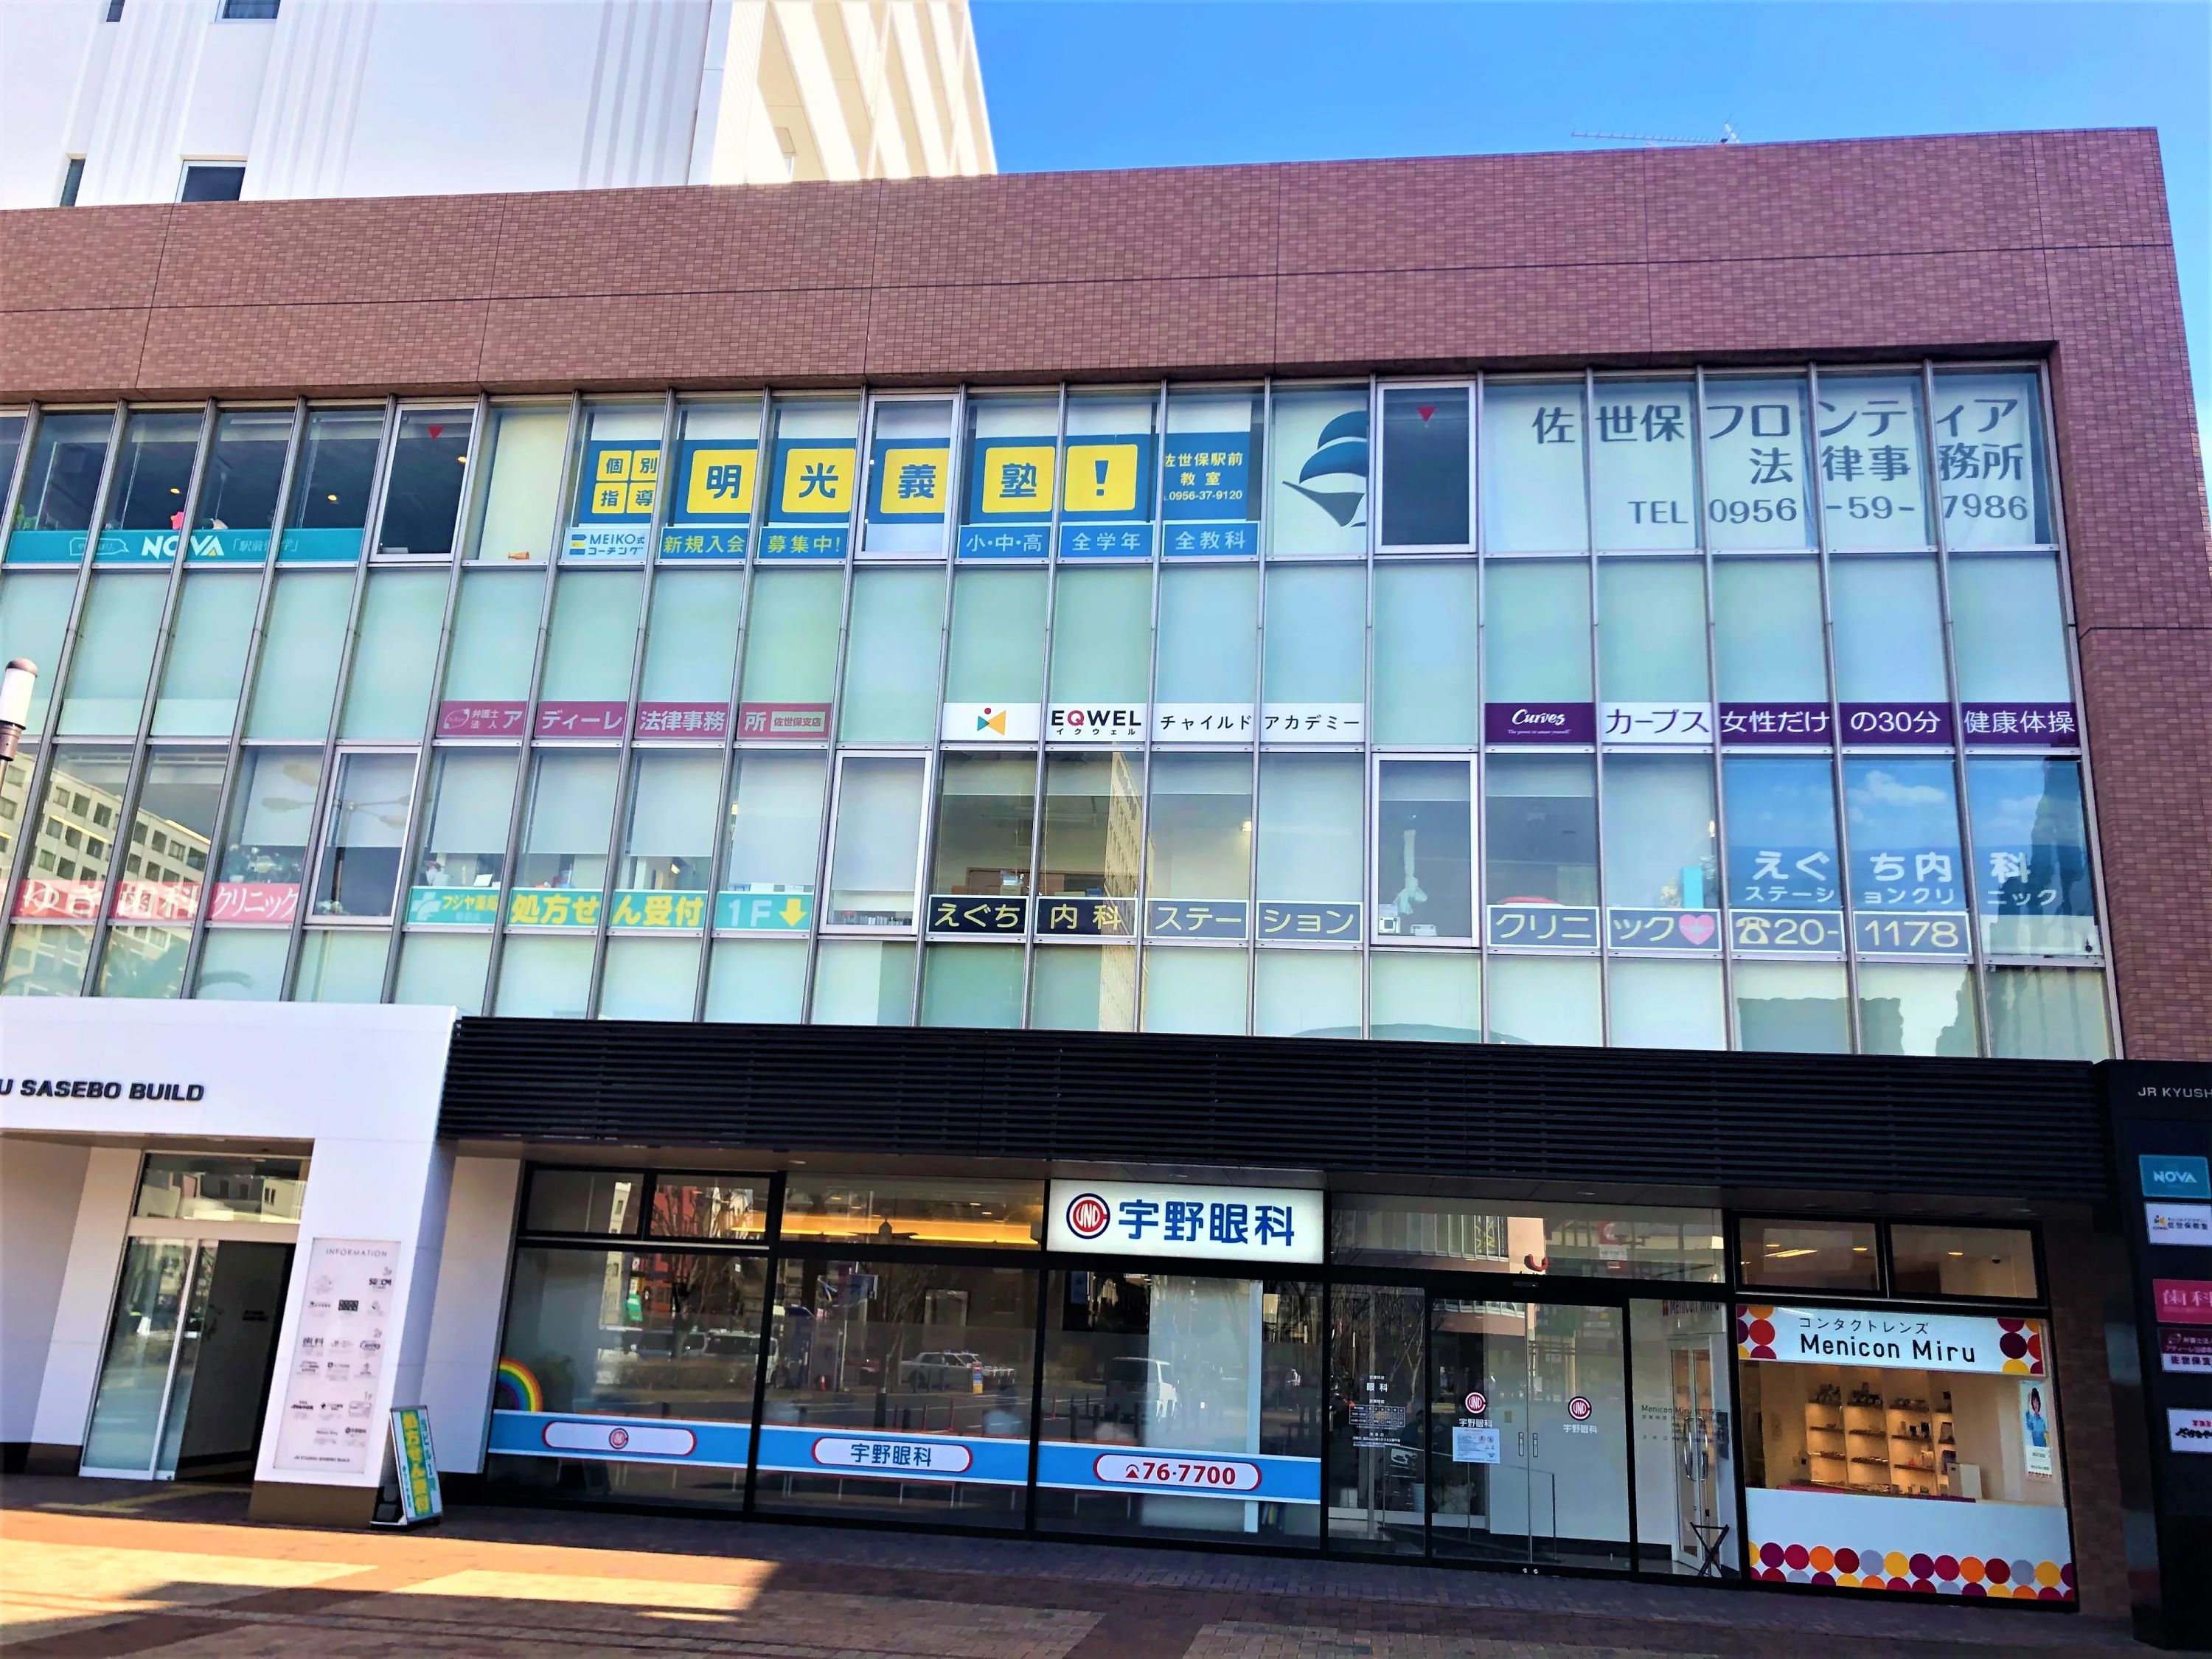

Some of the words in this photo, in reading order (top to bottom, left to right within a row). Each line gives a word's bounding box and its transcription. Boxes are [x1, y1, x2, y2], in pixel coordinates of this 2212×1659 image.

[1532, 399, 2018, 444] 佐世保フロンティア
[606, 458, 658, 474] 個別
[1749, 442, 2024, 484] 法律事務所
[1180, 471, 1221, 486] 教室
[601, 490, 655, 507] 指導
[1169, 490, 1243, 501] 0956-37-9120
[1628, 501, 1688, 524] TEL
[663, 535, 745, 554] 新規入会
[1072, 532, 1141, 552] 全学年
[1175, 529, 1246, 551] 全教科
[588, 546, 644, 555] コーチング
[1051, 709, 1142, 727] EQWEL
[1512, 709, 1565, 726] Curves
[1606, 706, 1711, 734] カーブス
[1752, 850, 2031, 884] えぐち内科
[511, 894, 705, 927] 処方せん受付
[728, 899, 771, 928] 1F
[20, 1079, 122, 1100] SASEBO
[128, 1083, 205, 1102] BUILD
[2138, 1087, 2157, 1097] JR
[2153, 1171, 2198, 1183] NOVA
[1119, 1199, 1295, 1247] 宇野眼科
[326, 1248, 388, 1257] INFORMATION
[1800, 1317, 1929, 1335] コンタクトレンズ
[1801, 1334, 1900, 1359] Menicon
[1913, 1340, 1976, 1363] Miru
[1641, 1405, 1672, 1413] Menicon
[1458, 1418, 1493, 1428] 宇野眼科
[1563, 1424, 1599, 1434] 宇野眼科
[851, 1443, 932, 1467] 宇野眼科
